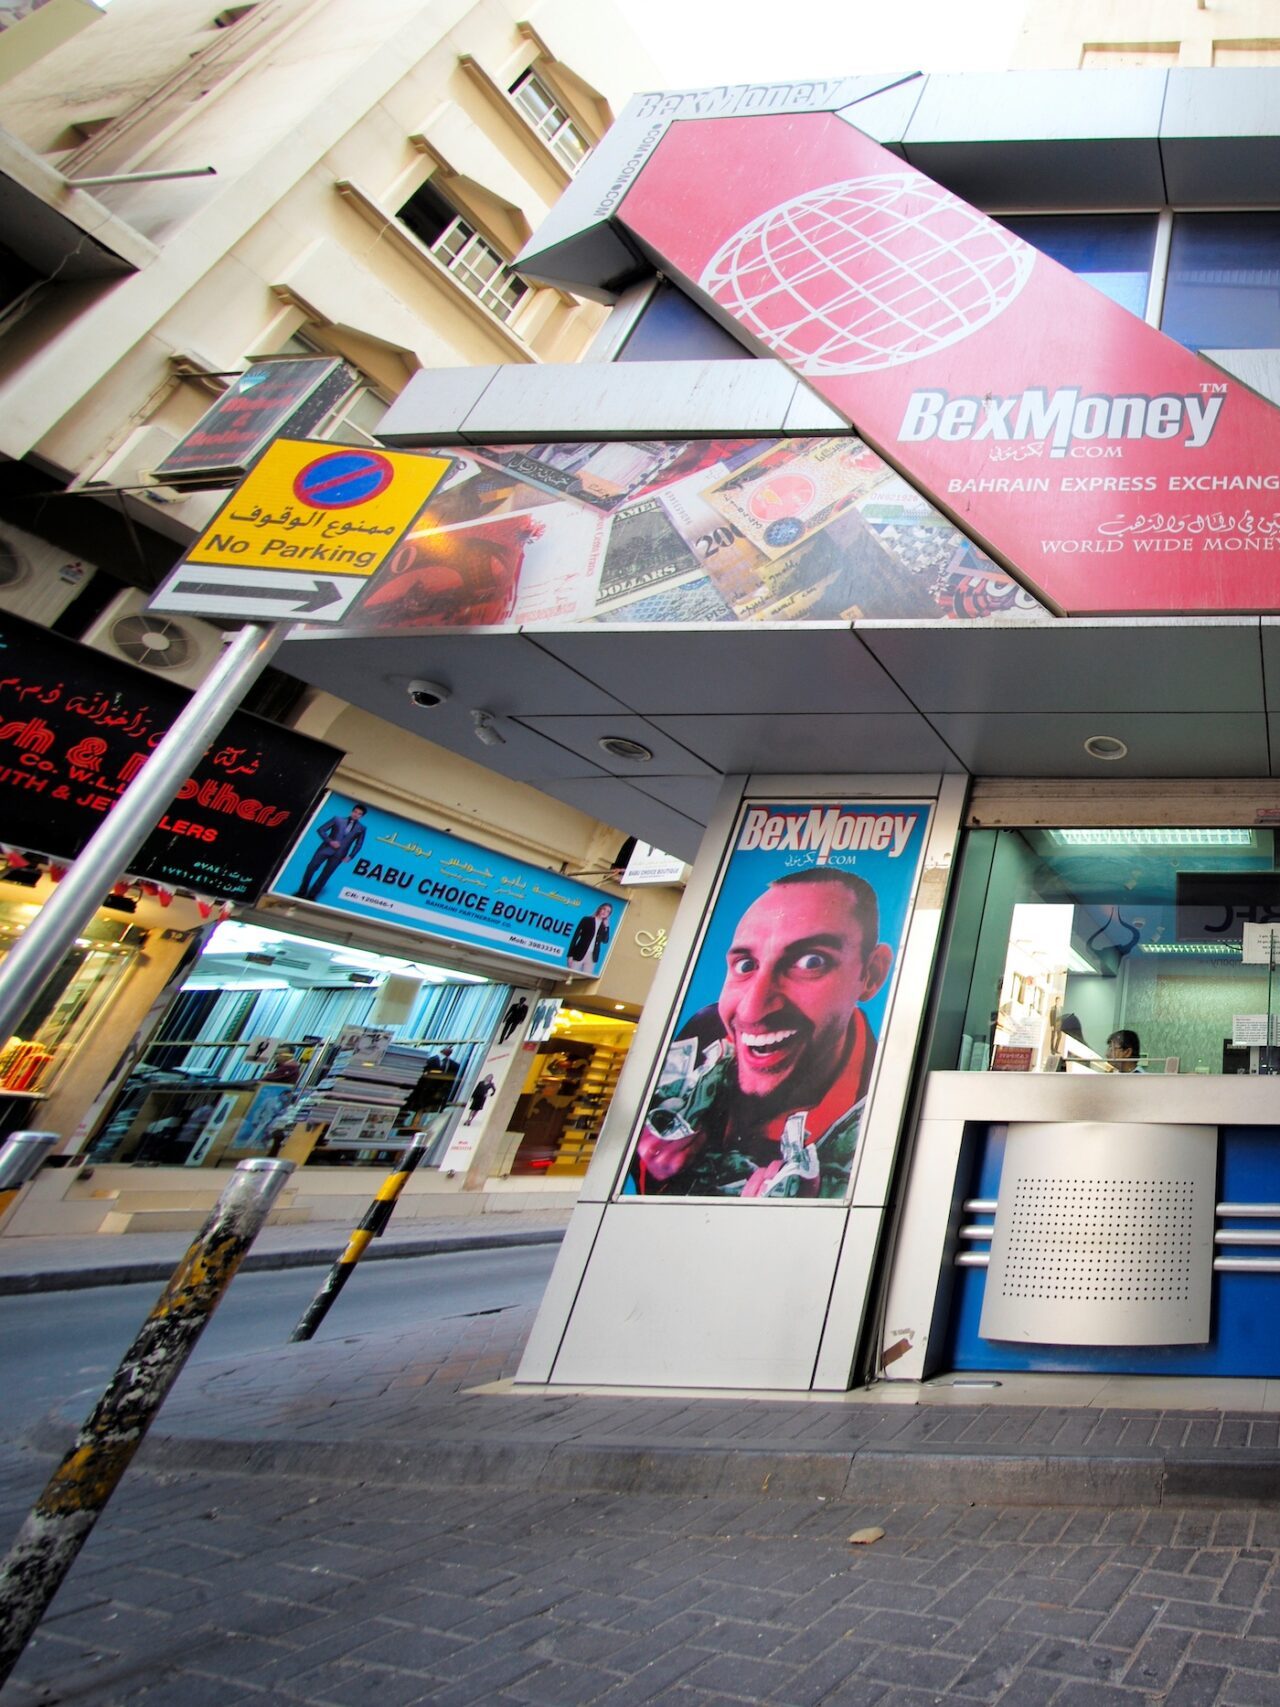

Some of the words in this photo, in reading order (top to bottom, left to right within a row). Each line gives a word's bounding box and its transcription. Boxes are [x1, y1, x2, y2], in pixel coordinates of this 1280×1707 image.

[897, 388, 1226, 458] BexMoney
[1199, 383, 1228, 394] TM
[948, 478, 1050, 494] BAHRAIN
[1060, 476, 1158, 492] EXPRESS
[229, 505, 328, 531] الوقوف
[320, 519, 396, 539] ممنوع
[204, 533, 250, 554] No
[260, 538, 377, 568] Parking
[1041, 539, 1124, 553] WORLD
[1132, 538, 1193, 552] WIDE
[19, 753, 59, 774] Co.
[65, 736, 108, 772] &
[51, 784, 71, 801] &
[737, 805, 918, 866] BexMoney
[353, 858, 414, 889] BABU
[417, 879, 490, 913] CHOICE
[491, 901, 574, 937] BOUTIQUE
